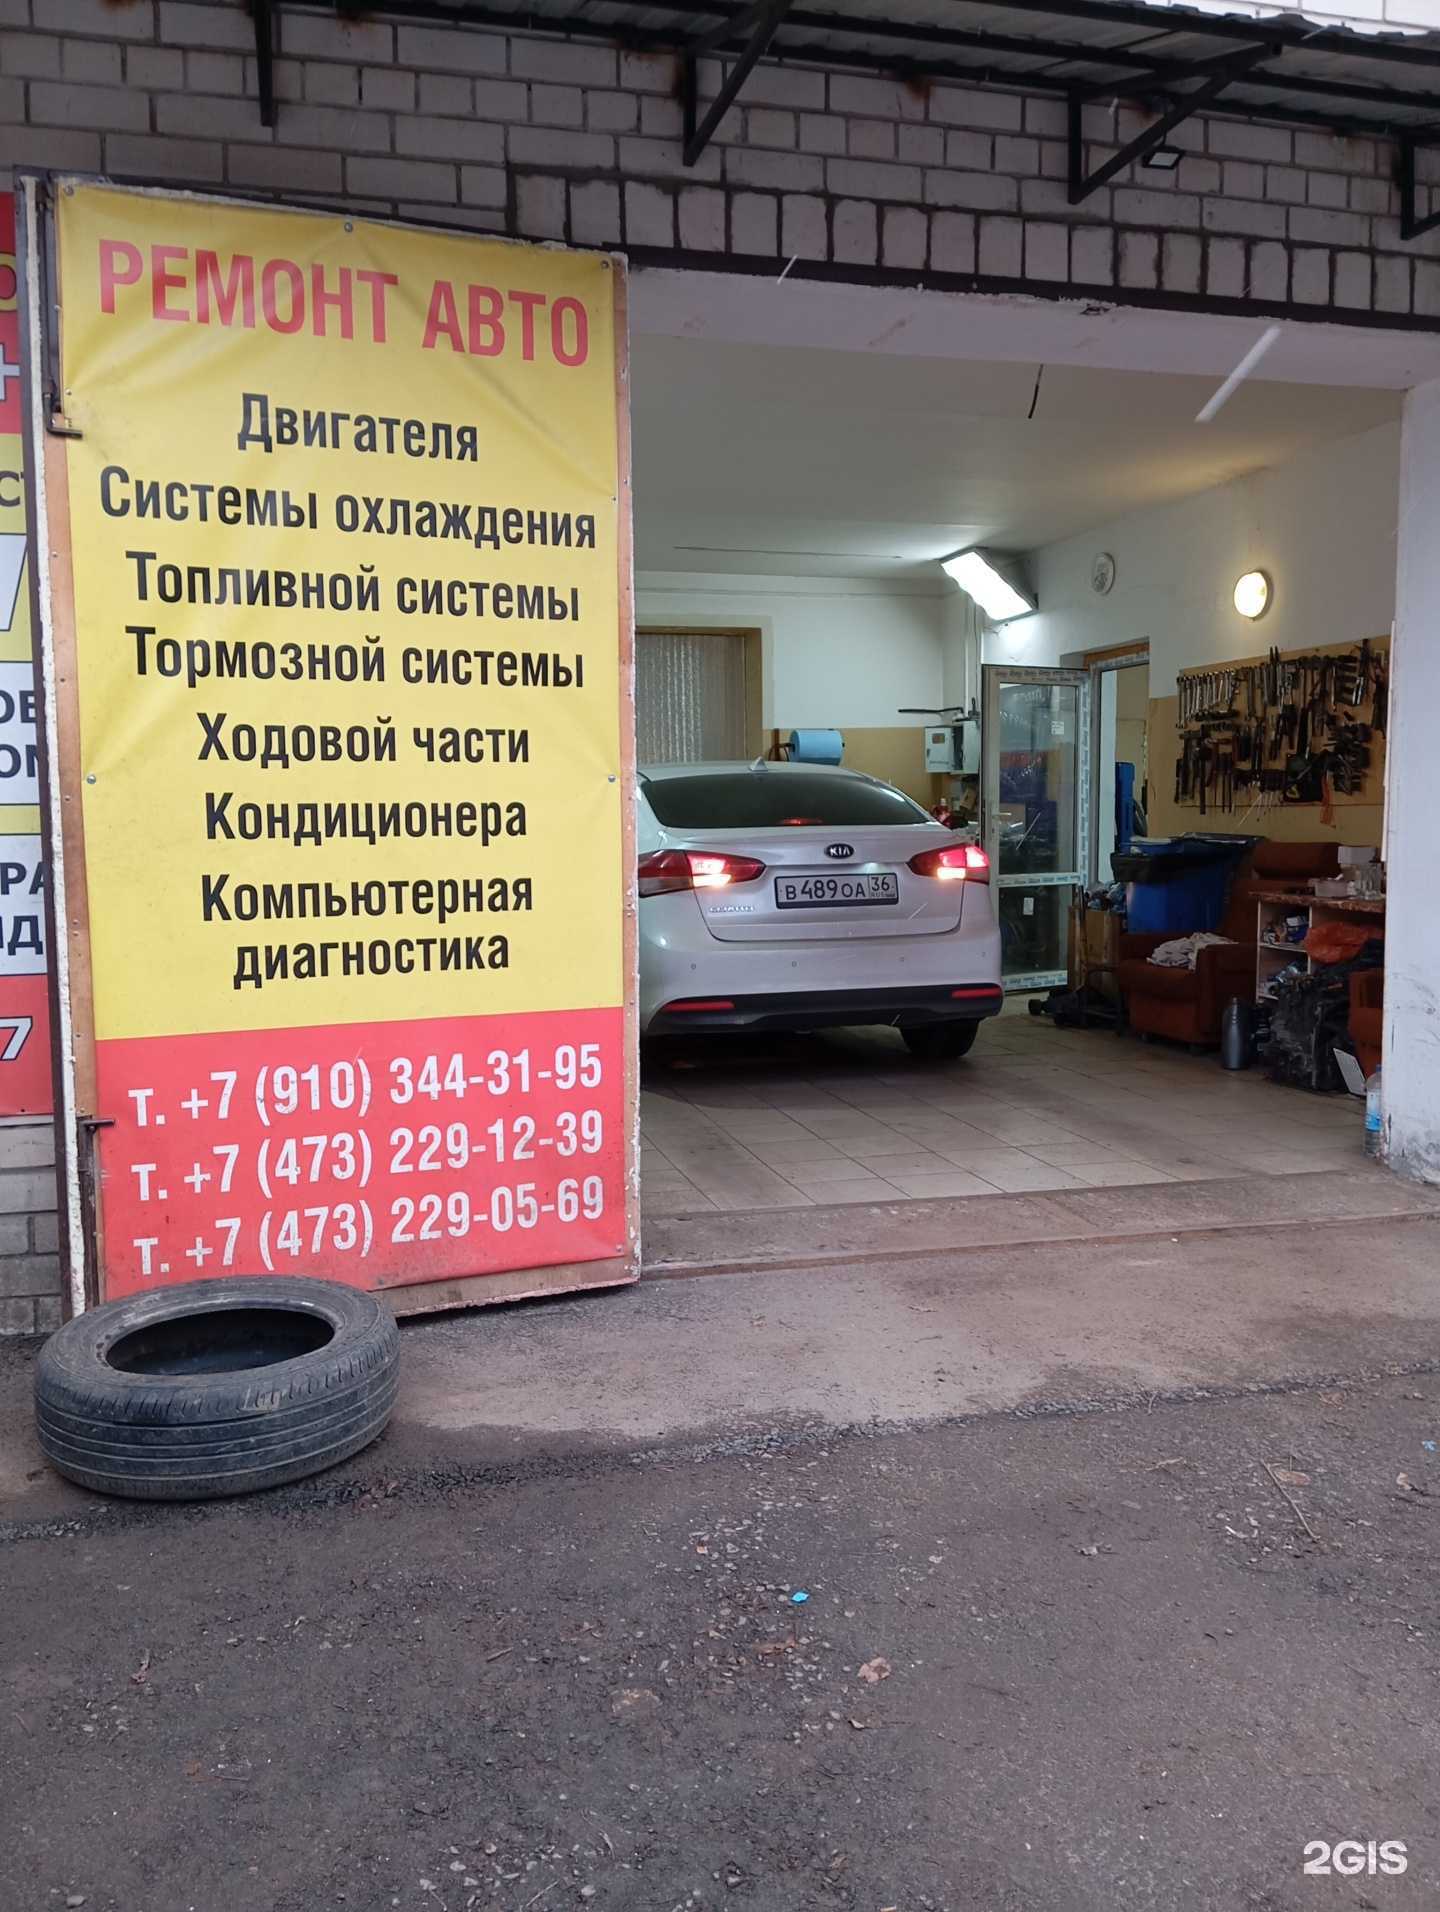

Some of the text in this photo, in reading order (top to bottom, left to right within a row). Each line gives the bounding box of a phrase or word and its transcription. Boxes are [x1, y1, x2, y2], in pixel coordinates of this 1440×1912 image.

[100, 240, 399, 343] РЕМОНТ
[422, 280, 588, 367] АВТО
[238, 393, 478, 462] Двигателя
[101, 466, 595, 550] Системы охлаждения
[126, 551, 579, 621] Топливной системы
[126, 625, 583, 688] Тормозной системы
[197, 712, 529, 769] Ходовой части
[205, 792, 527, 847] Кондиционера
[201, 874, 532, 924] Компьютерная
[871, 876, 890, 891] 36
[233, 935, 509, 990] диагностика
[181, 1070, 237, 1119] +7
[255, 1058, 372, 1127] (910)
[389, 1043, 602, 1104] 344-31-95
[183, 1144, 240, 1193] +7
[257, 1129, 372, 1199] (473)
[390, 1109, 603, 1173] 229-12-39
[185, 1217, 241, 1267] +7
[259, 1199, 373, 1271] (473)
[390, 1176, 603, 1243] 229-05-69
